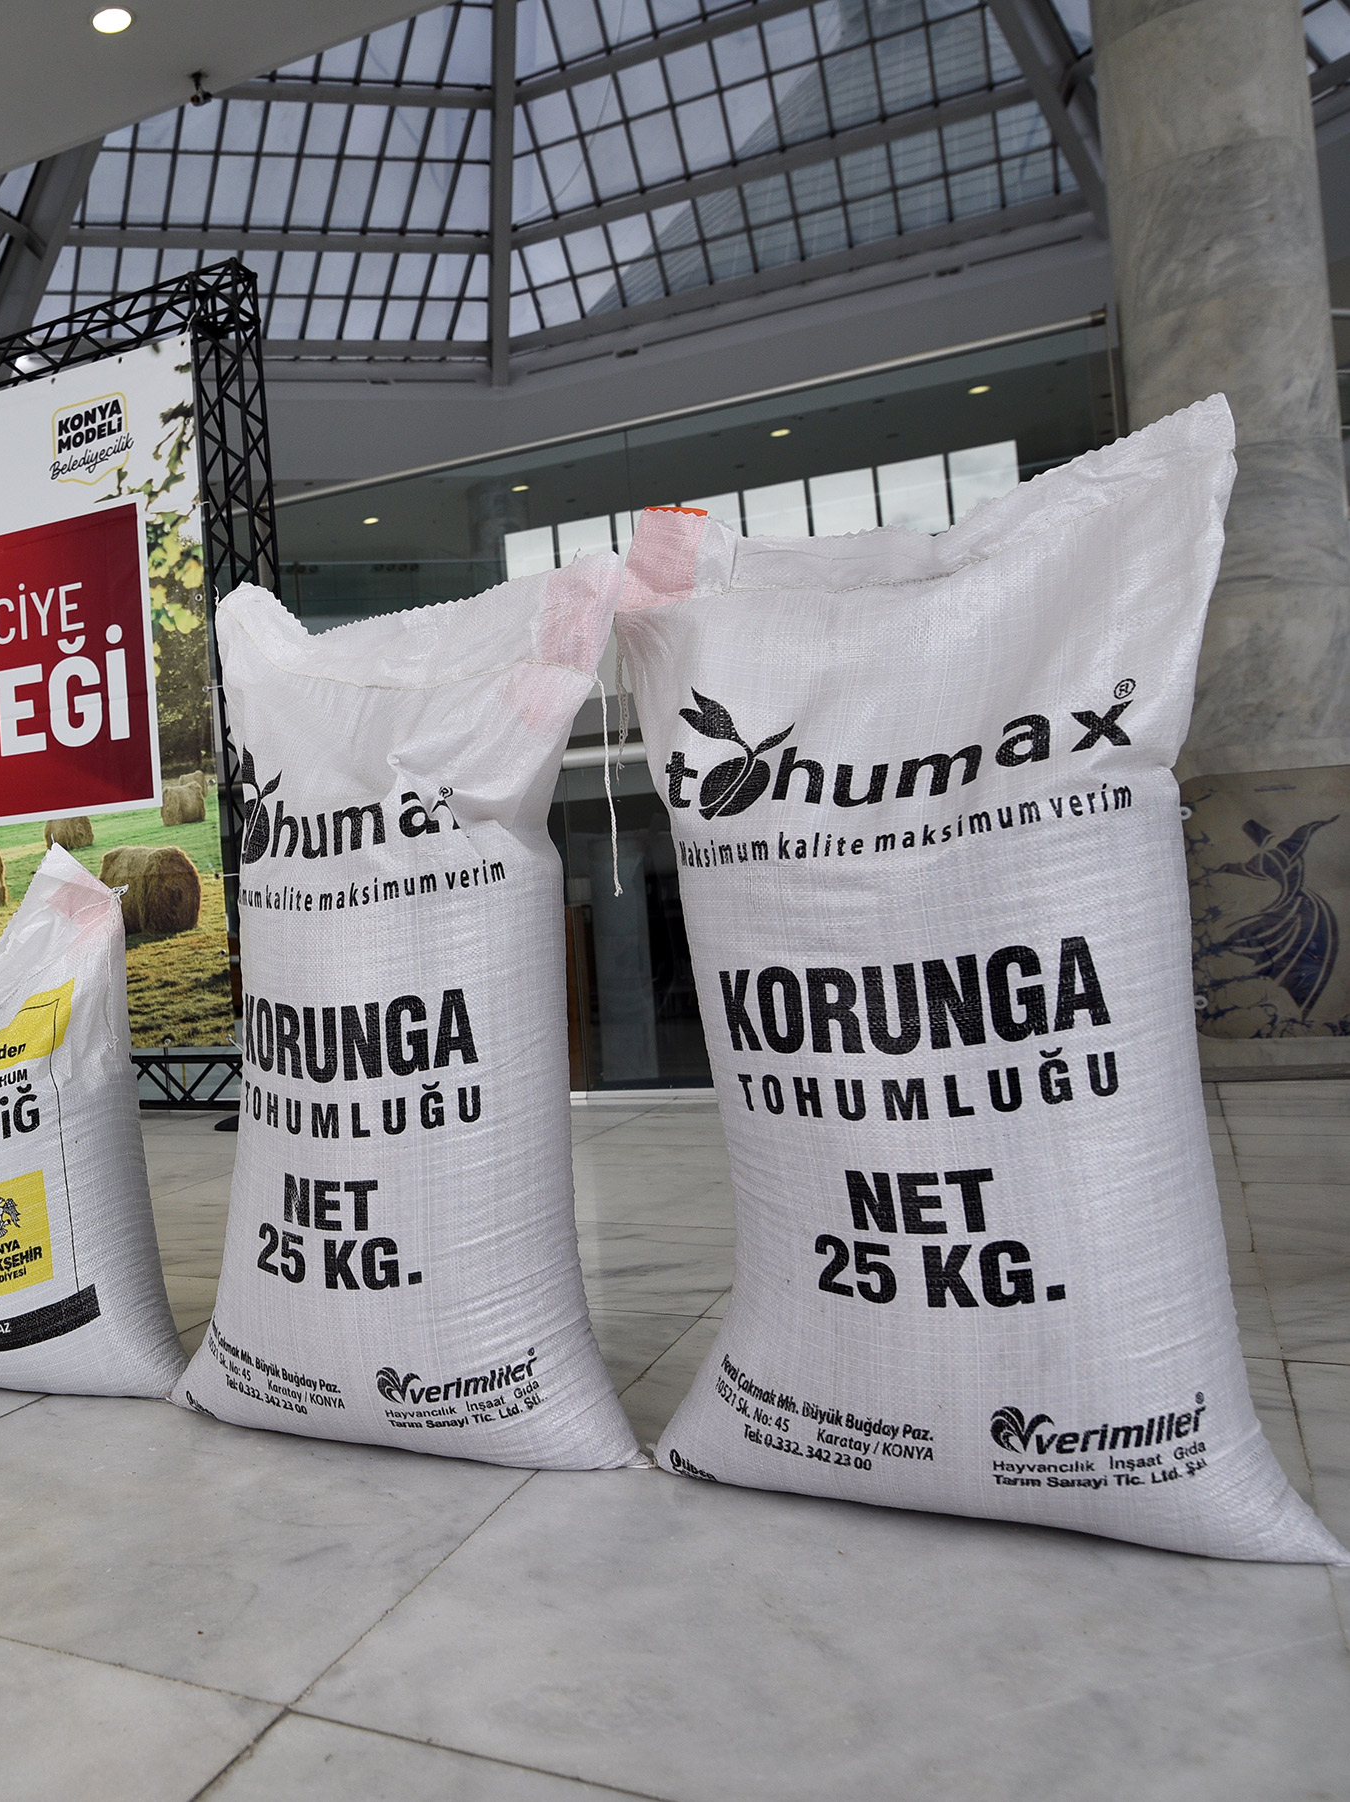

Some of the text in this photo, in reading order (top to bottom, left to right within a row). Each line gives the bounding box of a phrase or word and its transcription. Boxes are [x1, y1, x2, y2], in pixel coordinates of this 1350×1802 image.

[58, 399, 122, 437] KONYA
[49, 432, 134, 480] Belediyecilik
[778, 831, 864, 861] kalite
[874, 800, 1041, 854] maksimum
[1049, 782, 1133, 820] verim
[265, 859, 506, 912] kalite maksimum verim
[719, 935, 1112, 1055] KORUNGA
[245, 988, 480, 1083] KORUNGA
[245, 1081, 481, 1139] TOHUMLUĞU
[737, 1047, 1119, 1122] TOHUMLUĞU
[284, 1172, 378, 1232] NET
[845, 1168, 994, 1234] NET
[257, 1222, 423, 1291] 25 KG.
[815, 1234, 1066, 1309] 25 KG.
[242, 1367, 251, 1381] 45
[267, 1379, 302, 1403] Karatay
[309, 1393, 345, 1409] KONYA
[255, 1357, 281, 1378] Büyük
[281, 1367, 318, 1390] Buğday
[319, 1379, 341, 1394] Paz.
[264, 1393, 281, 1408] 342
[282, 1398, 294, 1411] 23
[295, 1404, 308, 1415] 00
[385, 1405, 457, 1420] Hayvancılık
[513, 1380, 540, 1399] Gıda
[736, 1398, 750, 1418] Sk.
[753, 1408, 772, 1426] No:
[774, 1416, 791, 1432] 45
[817, 1428, 871, 1454] Karatay
[882, 1444, 934, 1461] KONYA
[738, 1371, 777, 1404] Çakmak
[778, 1392, 799, 1414] Mh.
[802, 1401, 843, 1428] Büyük
[845, 1413, 899, 1440] Buğday
[902, 1424, 934, 1442] Paz.
[806, 1446, 831, 1464] 342
[834, 1453, 852, 1467] 23
[854, 1456, 872, 1471] 00
[992, 1460, 1095, 1475] Hayvancılık
[1173, 1440, 1207, 1460] Gıda
[992, 1467, 1183, 1490] Tarım Sanayi Tic. Ltd.
